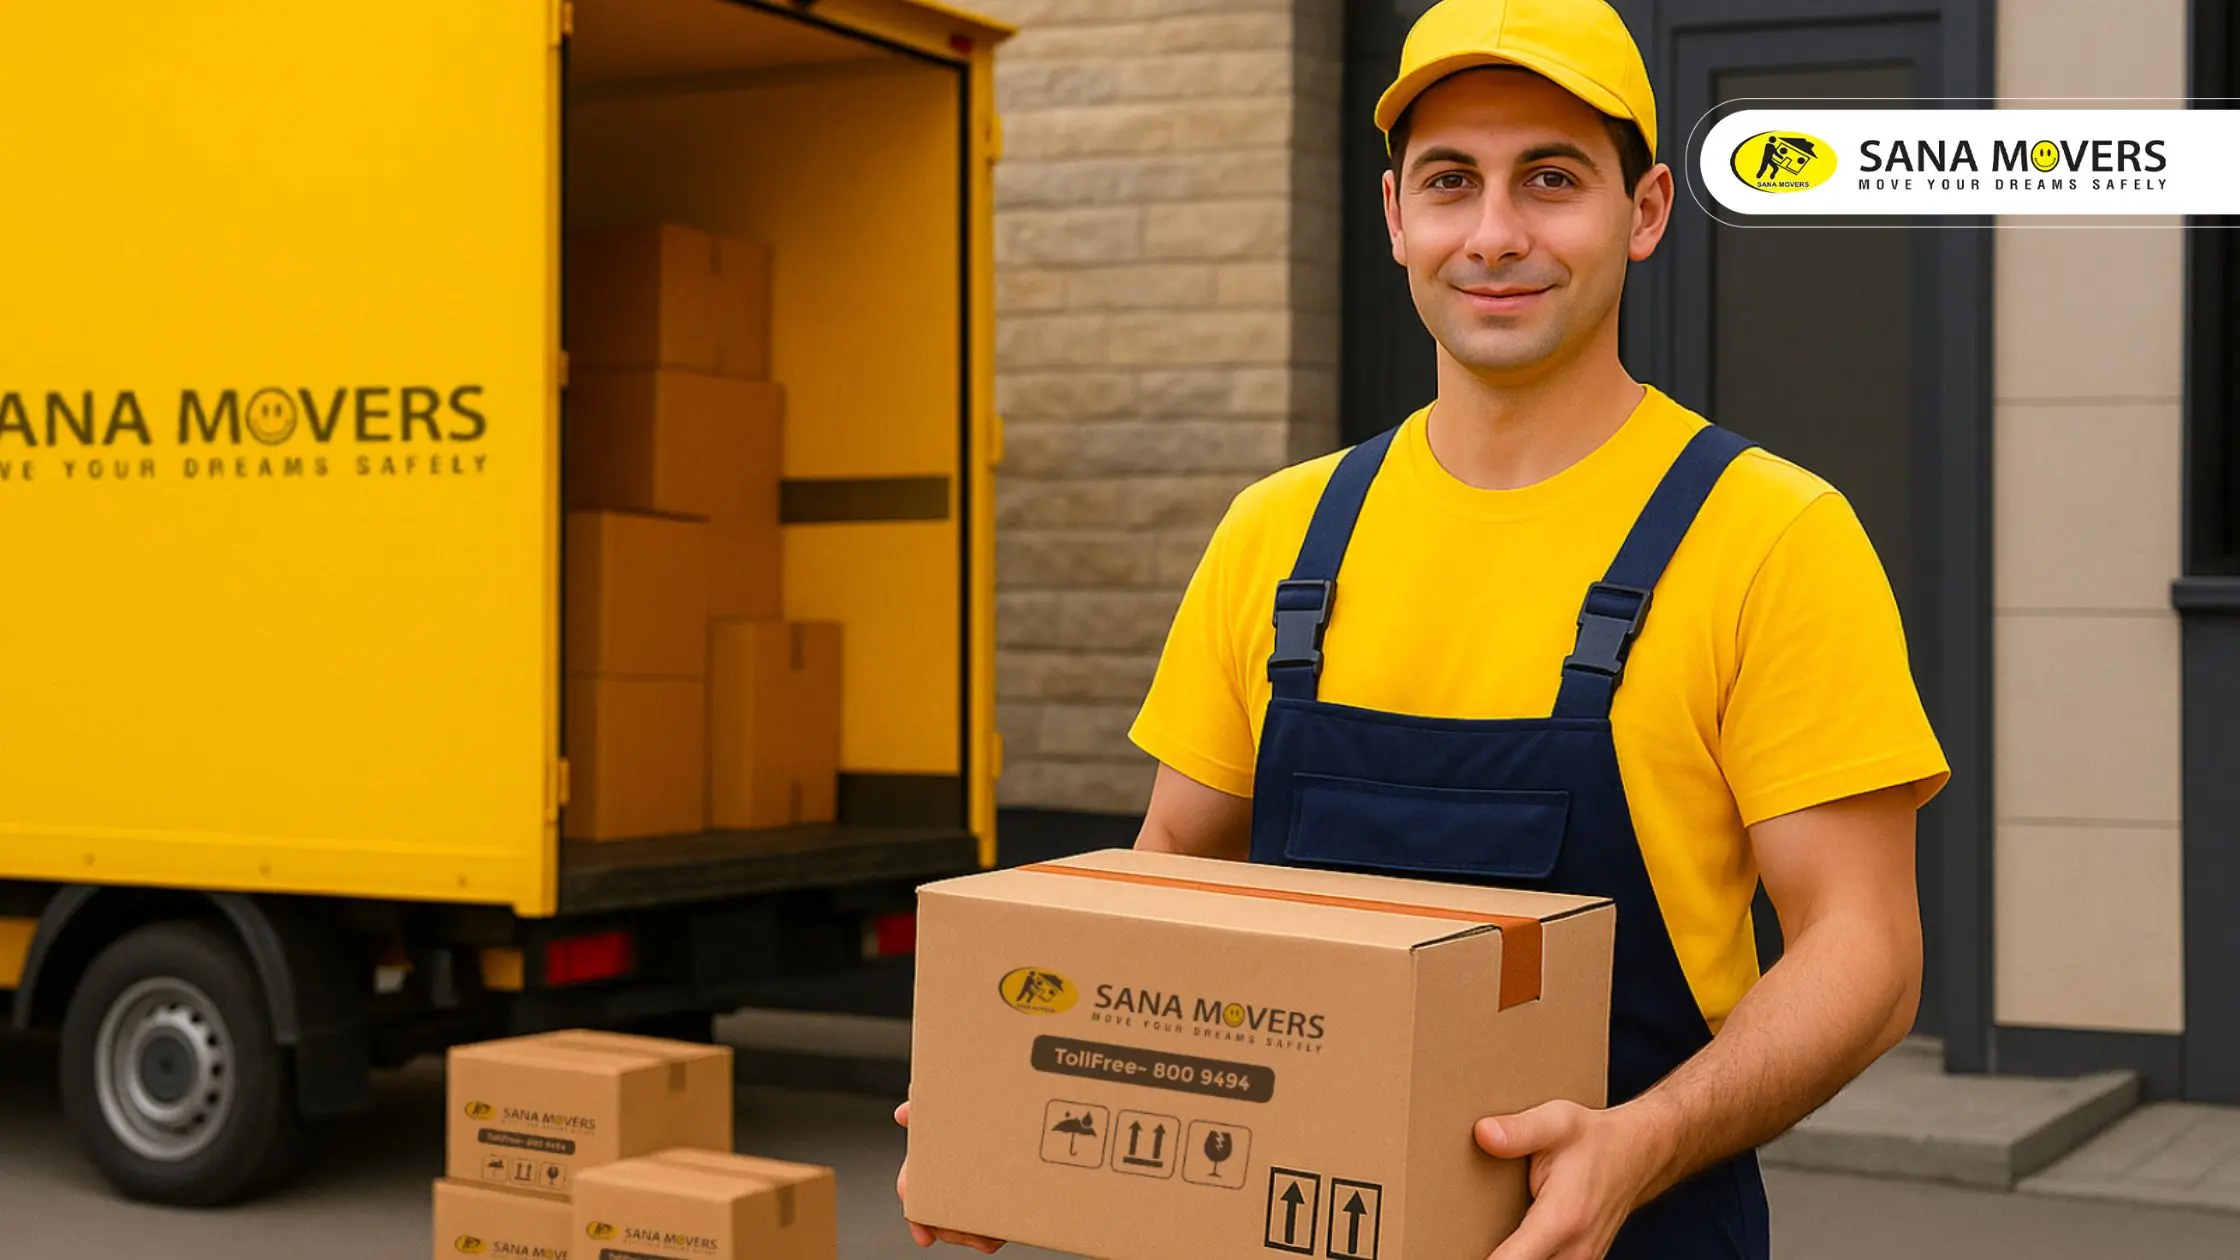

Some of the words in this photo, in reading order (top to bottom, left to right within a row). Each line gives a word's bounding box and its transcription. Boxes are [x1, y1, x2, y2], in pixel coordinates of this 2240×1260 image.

[0, 390, 152, 447] ANA
[178, 384, 487, 446] MOVERS
[62, 458, 156, 480] YOUR
[183, 456, 329, 479] DREAMS
[356, 454, 487, 476] SAFELY
[1095, 984, 1183, 1020] SANA
[1192, 998, 1325, 1039] MOVERS
[1091, 1012, 1132, 1027] MOVE
[1143, 1020, 1183, 1034] YOUR
[1193, 1026, 1256, 1045] DREAMS
[1266, 1037, 1323, 1054] SAFELY
[1055, 1047, 1147, 1075] TollFree-
[1153, 1061, 1195, 1083] 800
[1200, 1069, 1251, 1092] 9494
[503, 1107, 539, 1121] SANA
[542, 1112, 596, 1130] MOVERS
[494, 1241, 529, 1256] SANA
[624, 1228, 660, 1242] SANA
[663, 1233, 718, 1250] MOVERS
